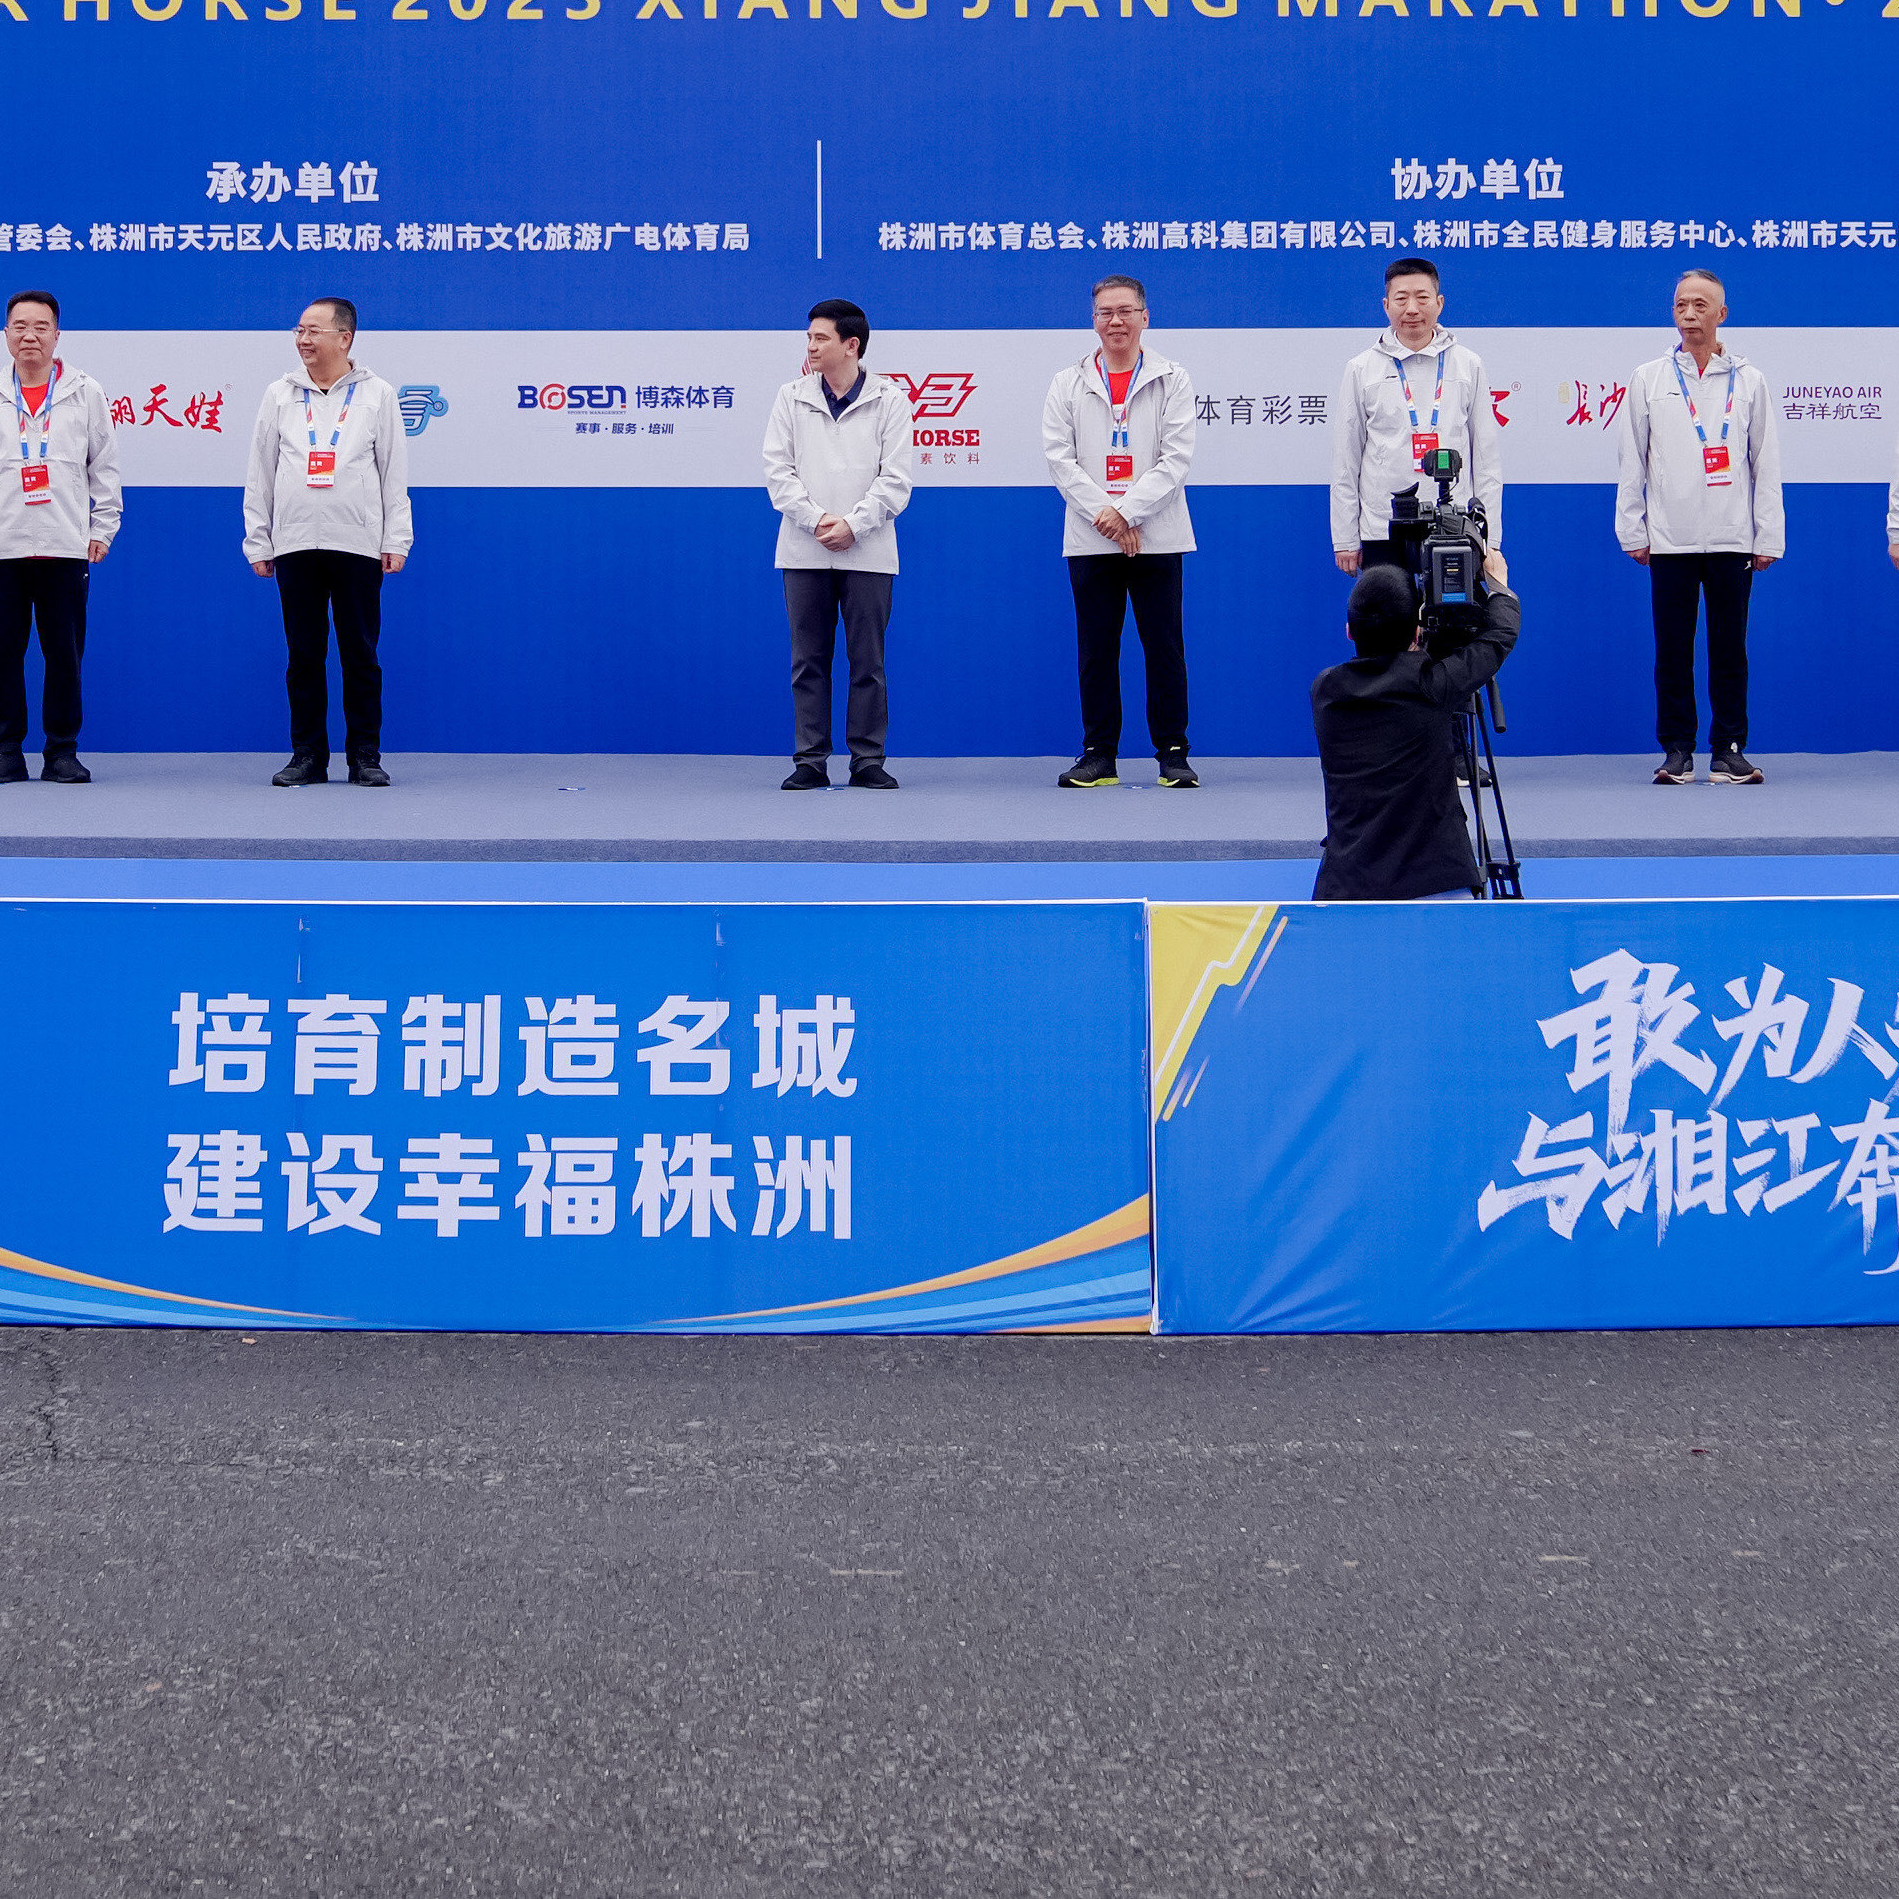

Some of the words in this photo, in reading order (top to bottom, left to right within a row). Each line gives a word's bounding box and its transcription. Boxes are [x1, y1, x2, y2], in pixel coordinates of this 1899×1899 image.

[205, 160, 379, 203] 承办单位
[1390, 157, 1565, 200] 协办单位
[517, 383, 627, 411] BOSEN
[635, 385, 736, 409] 博森体育
[1782, 385, 1854, 399] JUNEYAO
[1857, 385, 1883, 399] AIR
[1195, 394, 1328, 426] 体育彩票
[1782, 402, 1883, 420] 吉祥航空
[167, 991, 859, 1099] 培育制造名城
[162, 1129, 854, 1241] 建设幸福株洲
